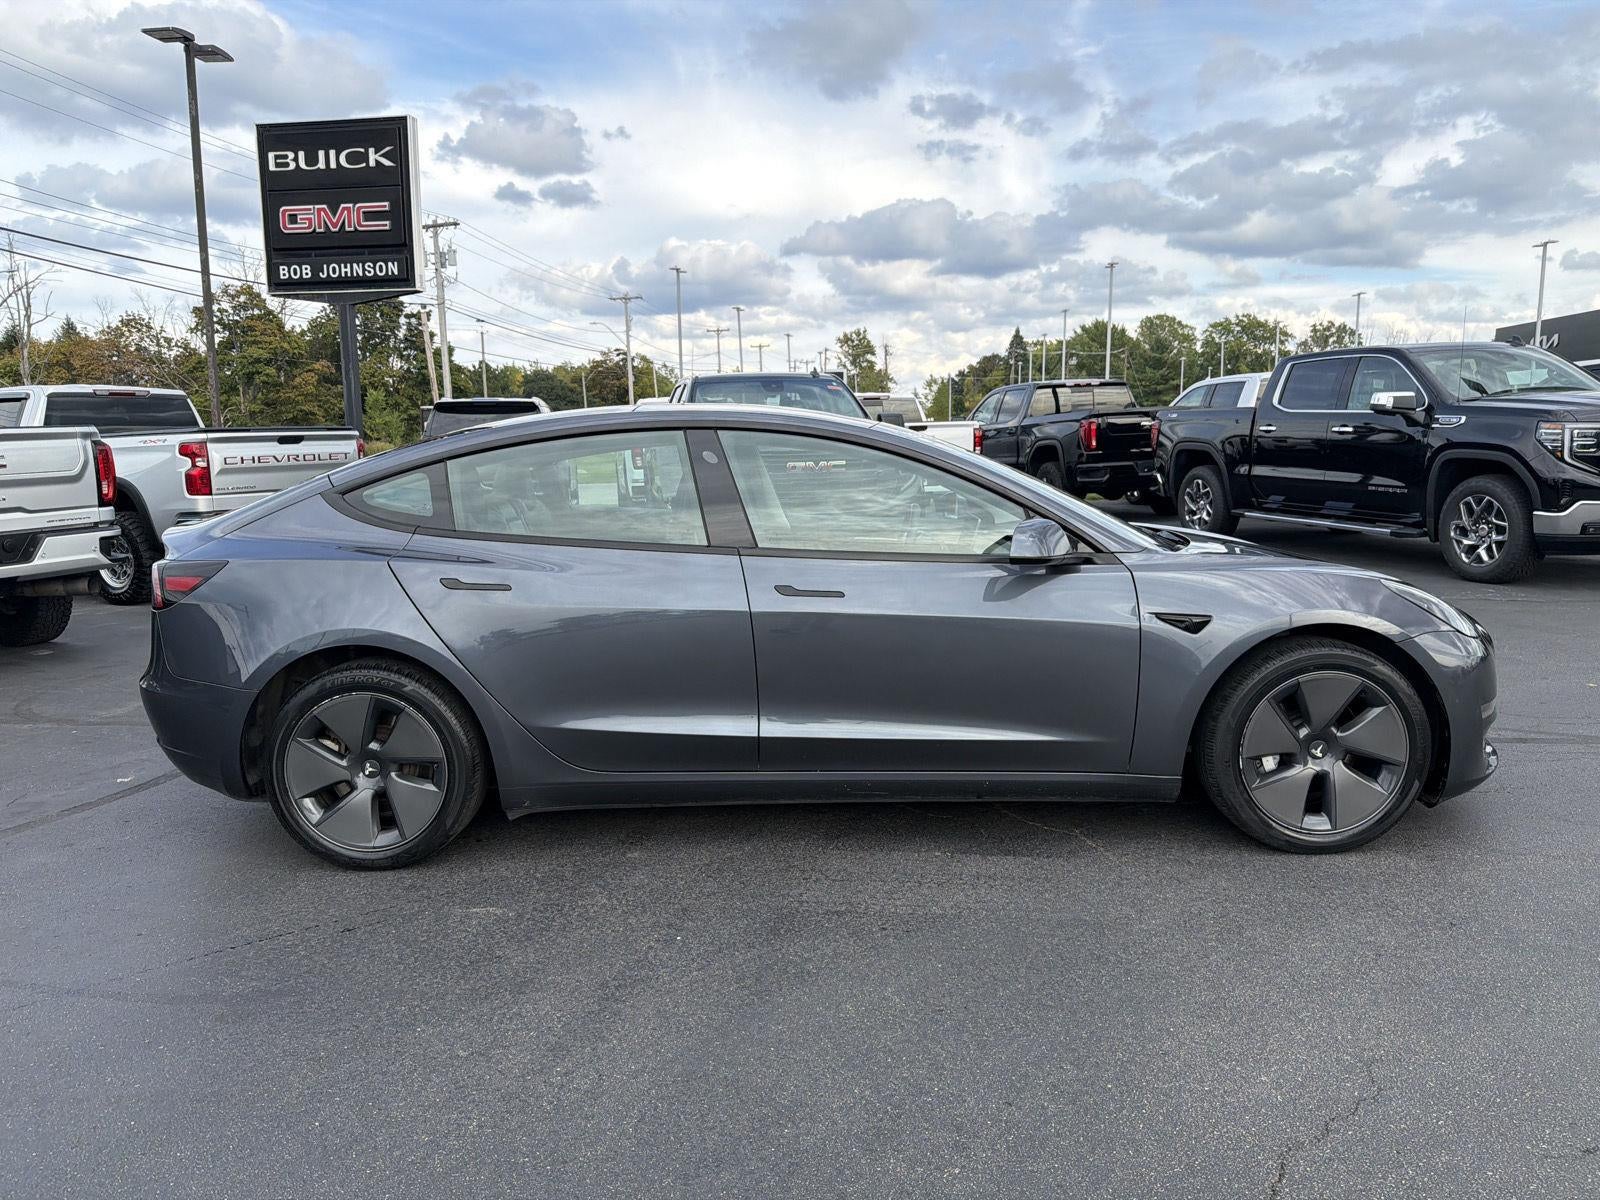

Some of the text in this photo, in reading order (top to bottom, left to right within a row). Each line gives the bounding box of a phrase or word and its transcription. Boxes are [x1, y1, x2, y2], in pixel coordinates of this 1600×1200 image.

[267, 146, 397, 171] BUICK
[279, 201, 392, 233] GMC
[279, 262, 398, 279] BOB JOHNSON
[223, 452, 351, 466] CHEVROLET
